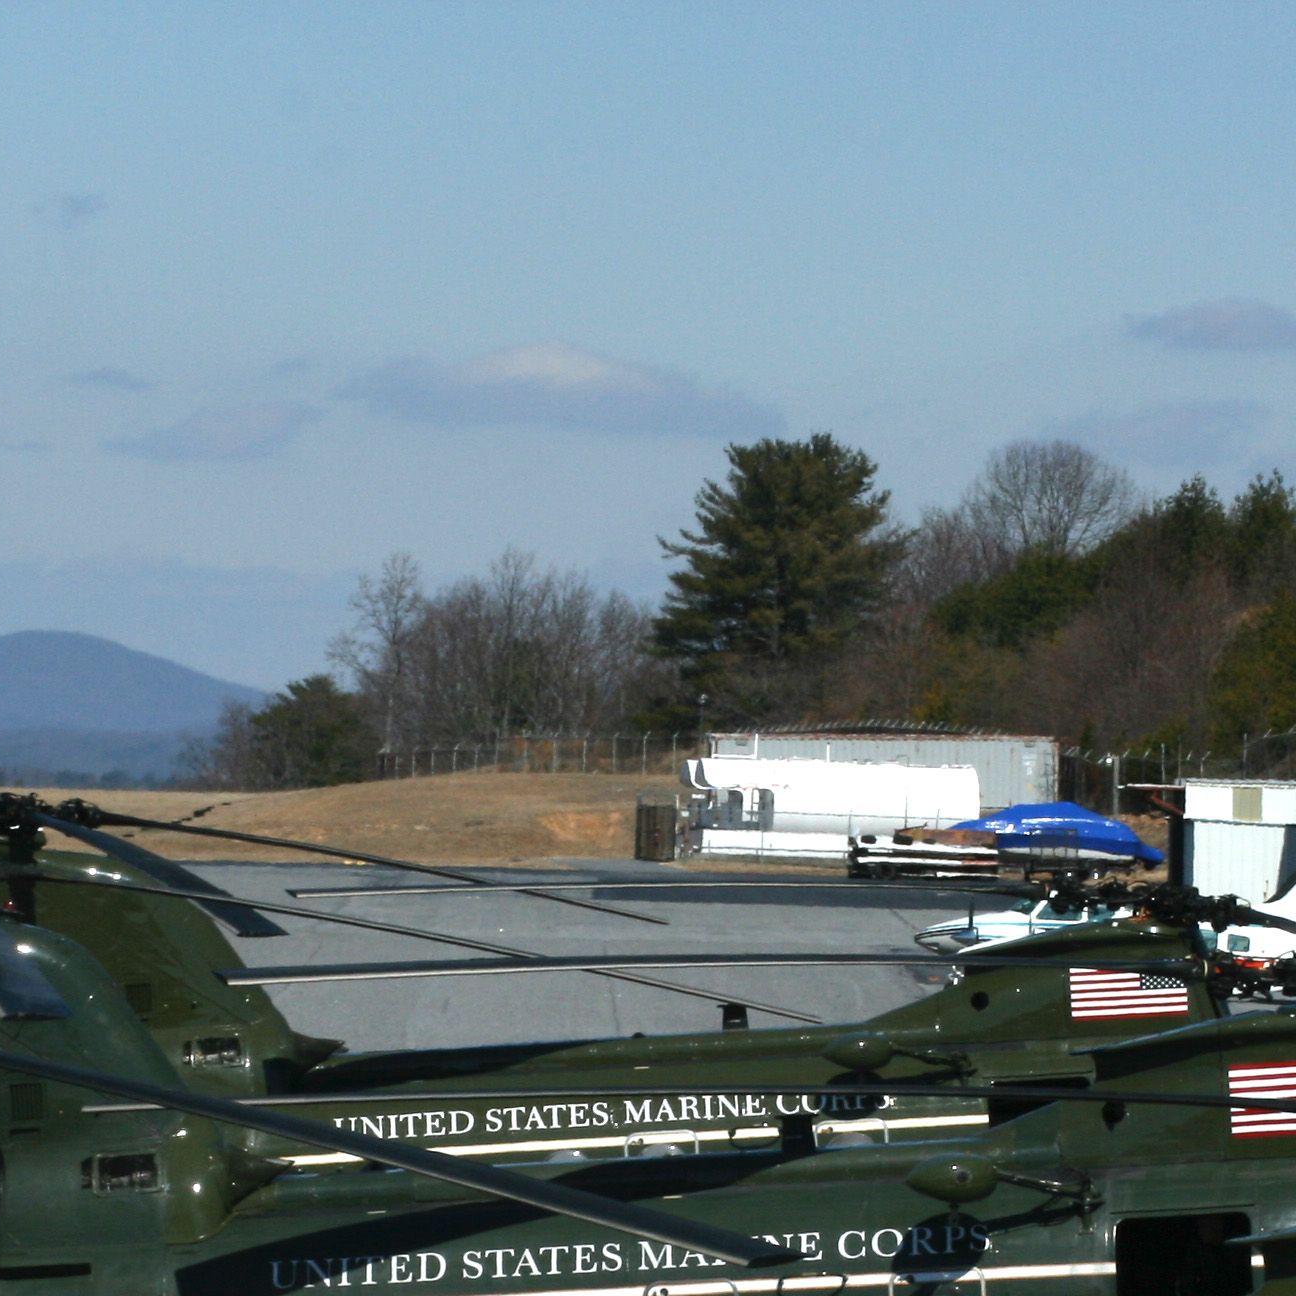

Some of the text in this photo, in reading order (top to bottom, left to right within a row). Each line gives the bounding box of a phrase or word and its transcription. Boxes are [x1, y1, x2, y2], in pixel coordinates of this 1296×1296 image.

[485, 1102, 609, 1132] STATES
[623, 1094, 766, 1125] MARINE
[270, 1252, 447, 1289] UNITED
[462, 1242, 624, 1279] STATES
[838, 1224, 992, 1260] CORPS
